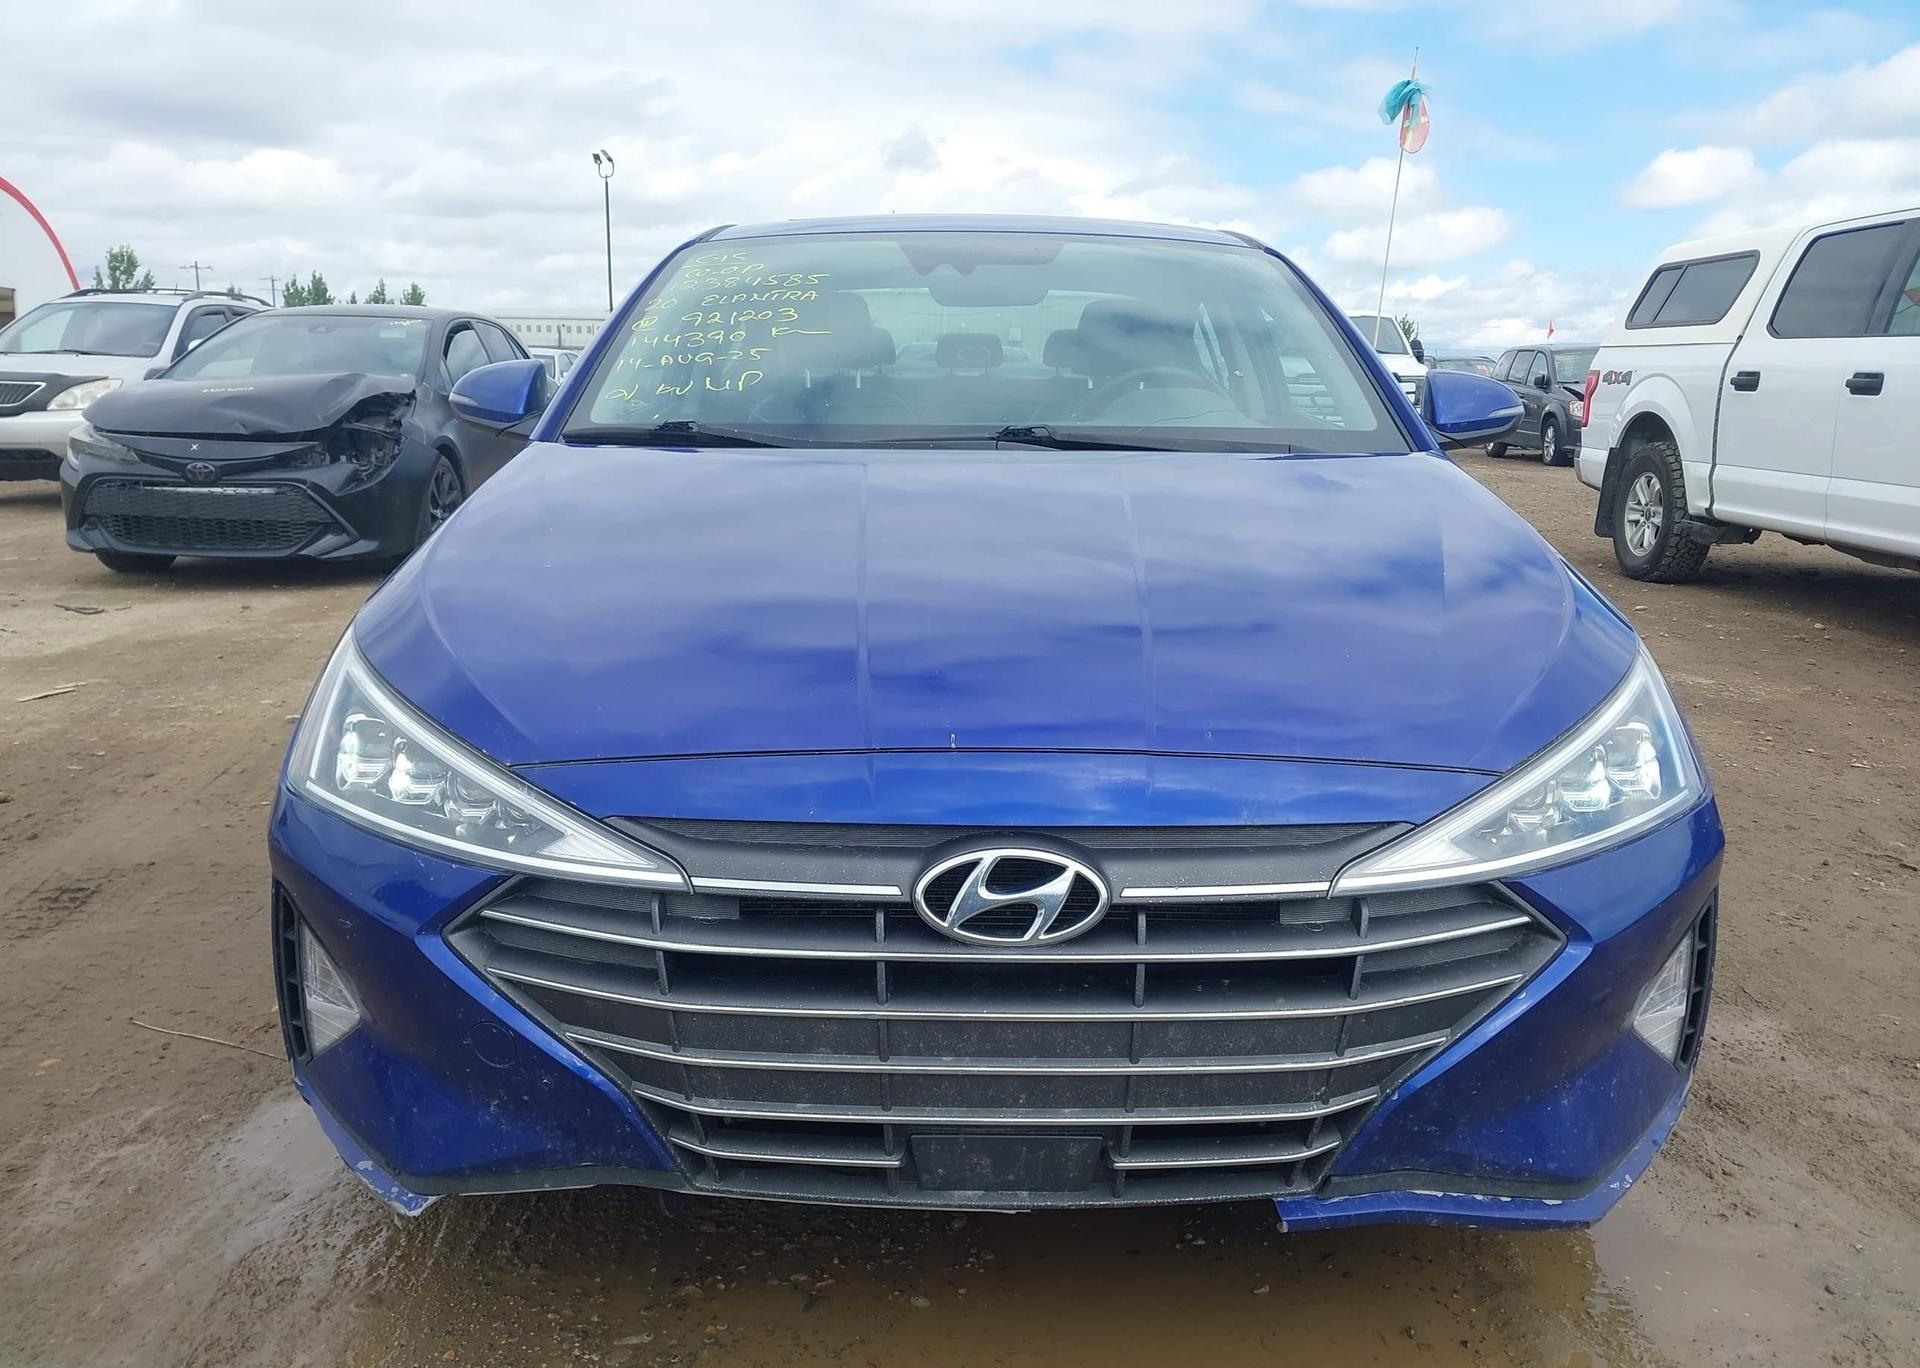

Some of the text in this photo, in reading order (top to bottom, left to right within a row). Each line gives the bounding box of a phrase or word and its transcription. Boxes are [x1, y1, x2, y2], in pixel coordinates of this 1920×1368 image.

[701, 290, 819, 308] ELANTRA
[681, 307, 799, 327] 921203
[631, 330, 746, 348] 144390
